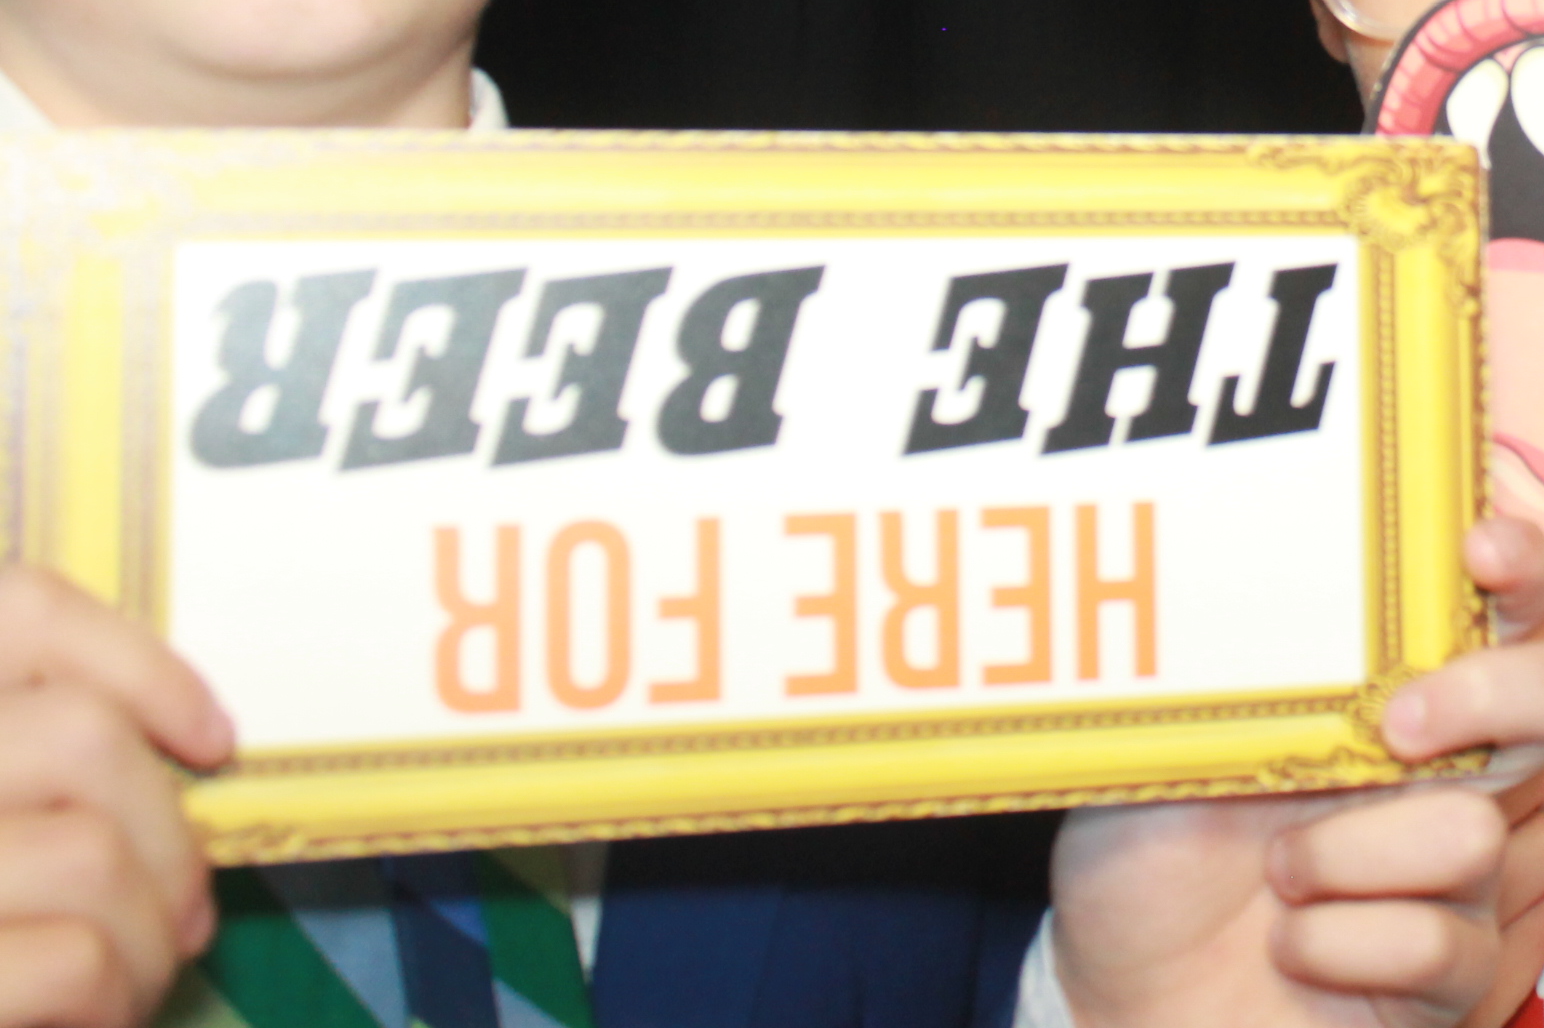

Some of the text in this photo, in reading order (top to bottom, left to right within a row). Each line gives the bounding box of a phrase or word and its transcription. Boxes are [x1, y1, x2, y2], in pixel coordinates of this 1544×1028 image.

[188, 260, 1340, 473] THE BEER
[430, 498, 1161, 718] HERE FOR
